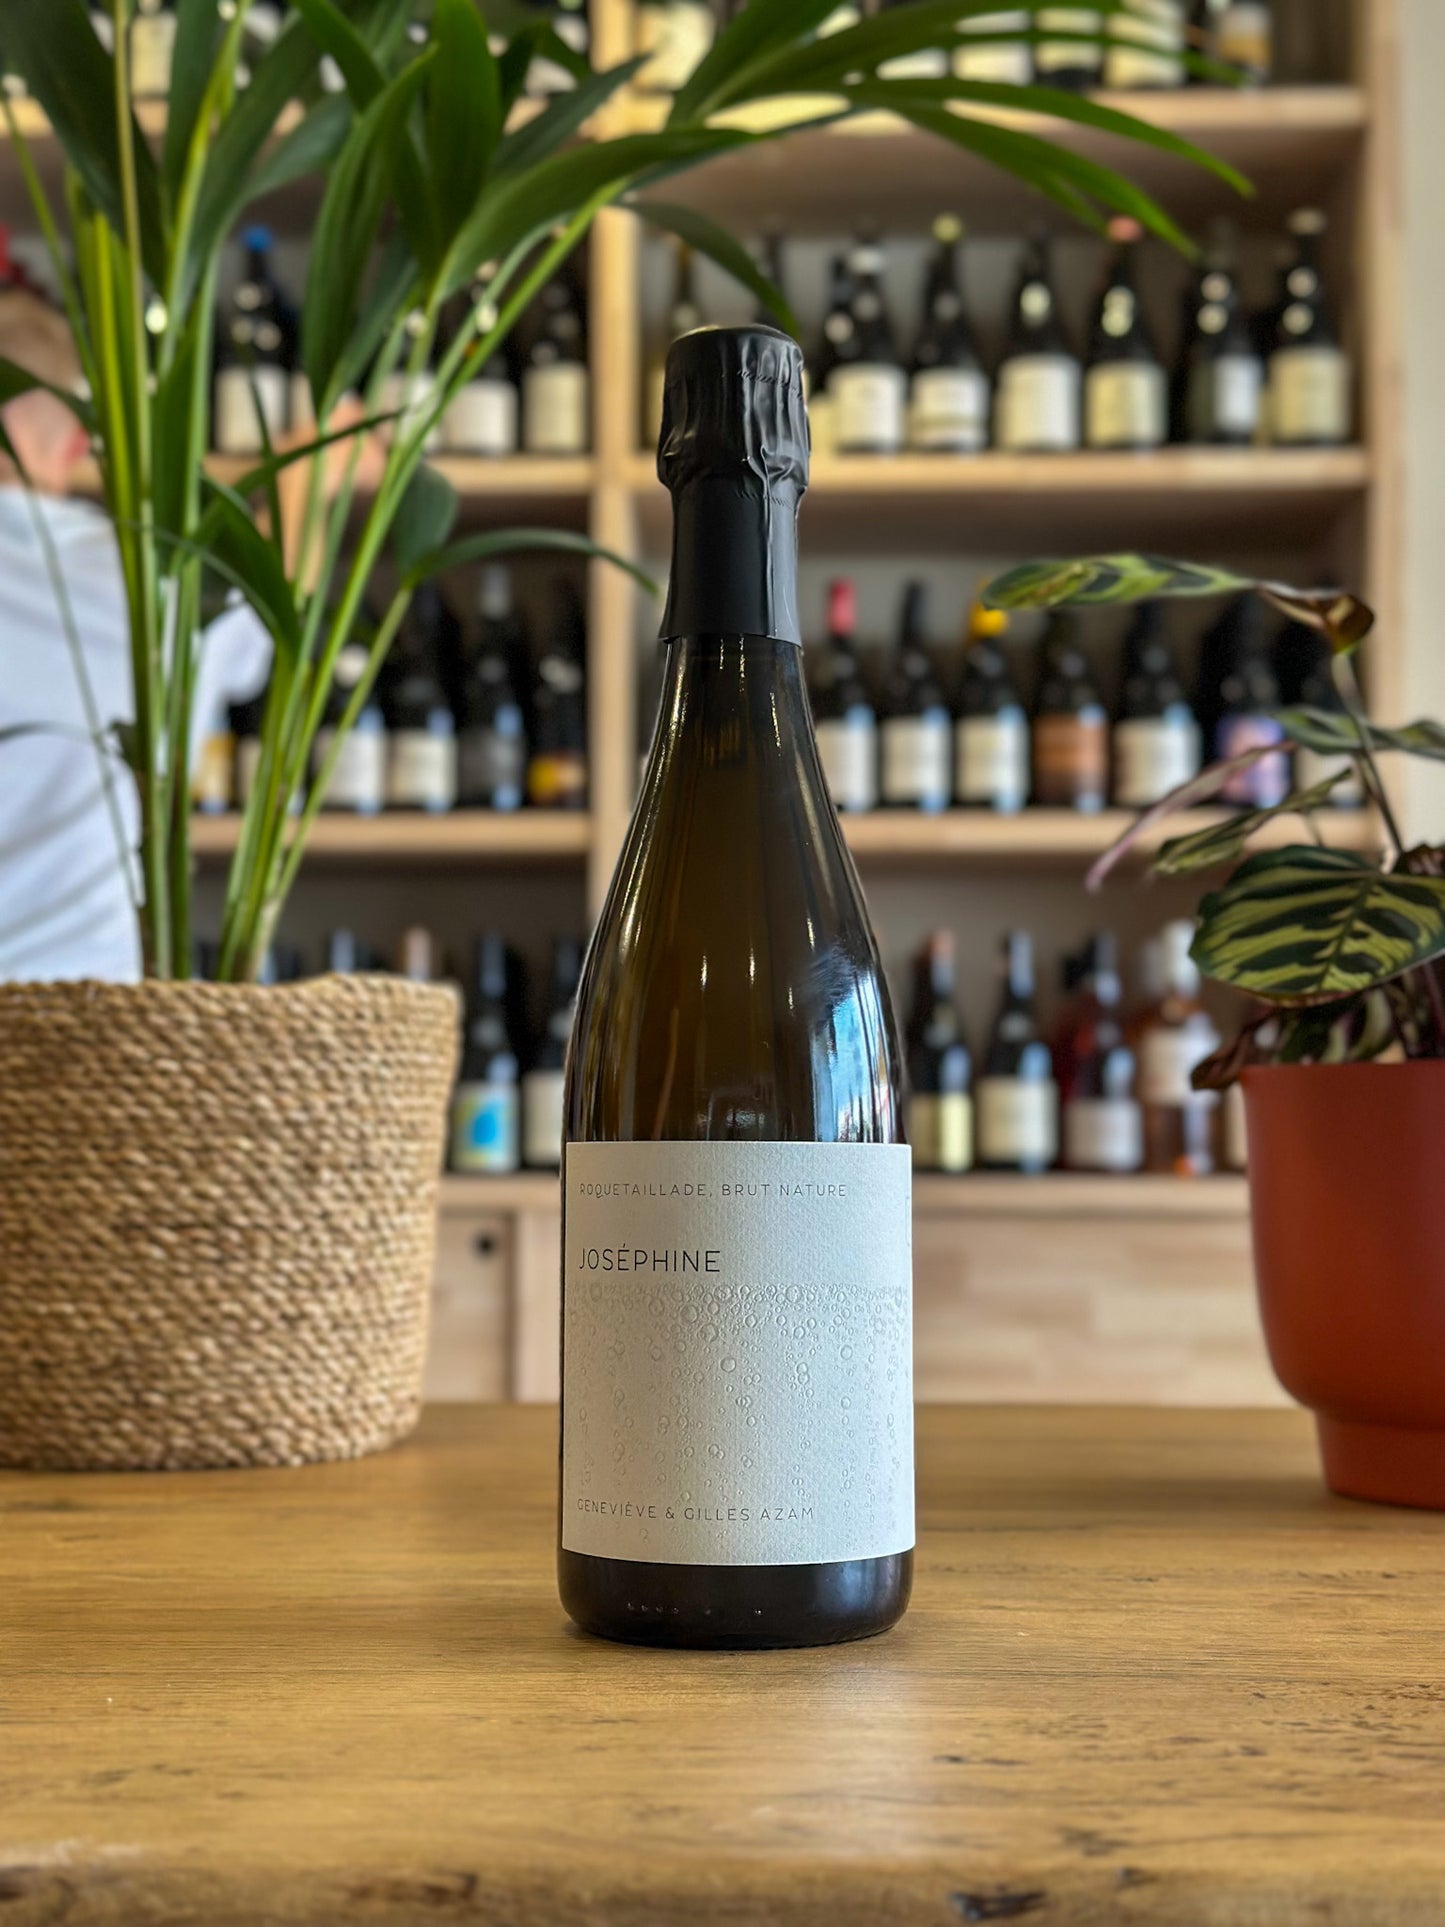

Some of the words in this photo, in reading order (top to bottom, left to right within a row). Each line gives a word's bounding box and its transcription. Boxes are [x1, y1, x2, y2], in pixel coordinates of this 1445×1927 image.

[580, 1183, 712, 1198] ROQUETAILLADE,
[721, 1183, 770, 1196] BRUT
[779, 1184, 847, 1197] NATURE
[579, 1243, 721, 1272] JOSÉPHINE
[665, 1506, 675, 1520] &
[684, 1507, 750, 1521] GILLES
[760, 1507, 814, 1521] AZAM
